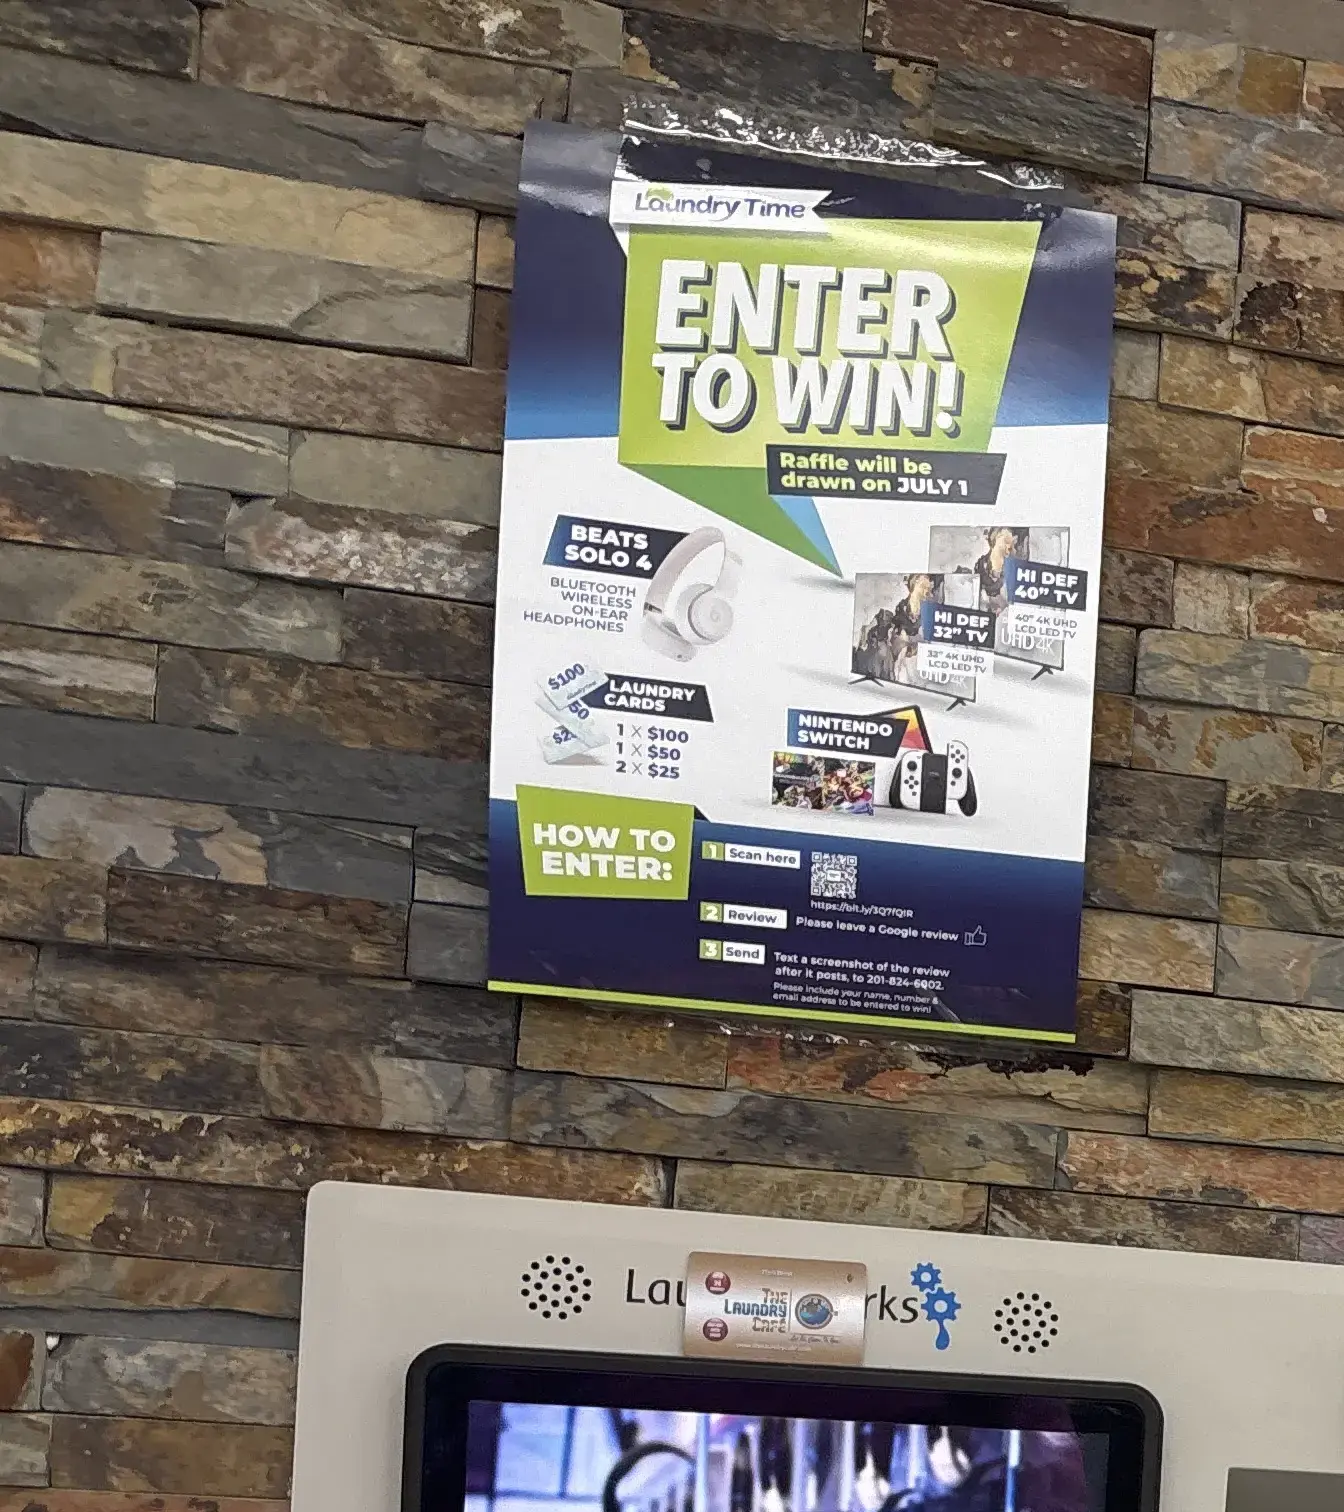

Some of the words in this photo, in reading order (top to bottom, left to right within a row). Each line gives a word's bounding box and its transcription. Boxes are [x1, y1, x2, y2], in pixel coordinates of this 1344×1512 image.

[634, 192, 742, 222] Laundry
[743, 199, 805, 219] Time
[653, 258, 955, 361] ENTER
[652, 353, 756, 431] TO
[771, 355, 964, 438] WIN!
[780, 452, 849, 473] Raffle
[855, 456, 897, 475] will
[903, 459, 932, 475] be
[781, 471, 856, 492] drawn
[862, 477, 891, 492] on
[897, 476, 952, 497] JULY
[958, 479, 968, 496] 1
[571, 524, 648, 549] BEATS
[565, 545, 629, 568] SOLO
[636, 555, 652, 571] 4
[550, 577, 636, 597] BLUETOOTH
[1016, 568, 1037, 583] HI
[1041, 571, 1078, 587] DEF
[561, 591, 633, 609] WIRELESS
[1053, 588, 1078, 604] TV
[523, 611, 624, 633] HEADPHONES
[572, 604, 628, 621] ON-EAR
[609, 680, 695, 701] LAUNDRY
[604, 694, 666, 711] CARDS
[799, 714, 892, 736] NINTENDO
[798, 731, 869, 750] SWITCH
[533, 823, 619, 849] HOW
[630, 828, 675, 853] TO
[708, 844, 717, 858] 1
[729, 848, 762, 862] Scan
[766, 850, 797, 865] here
[542, 851, 673, 882] ENTER:
[796, 916, 833, 930] Please
[837, 920, 866, 933] leave
[869, 925, 875, 933] a
[878, 923, 918, 939] Google
[921, 930, 958, 941] review
